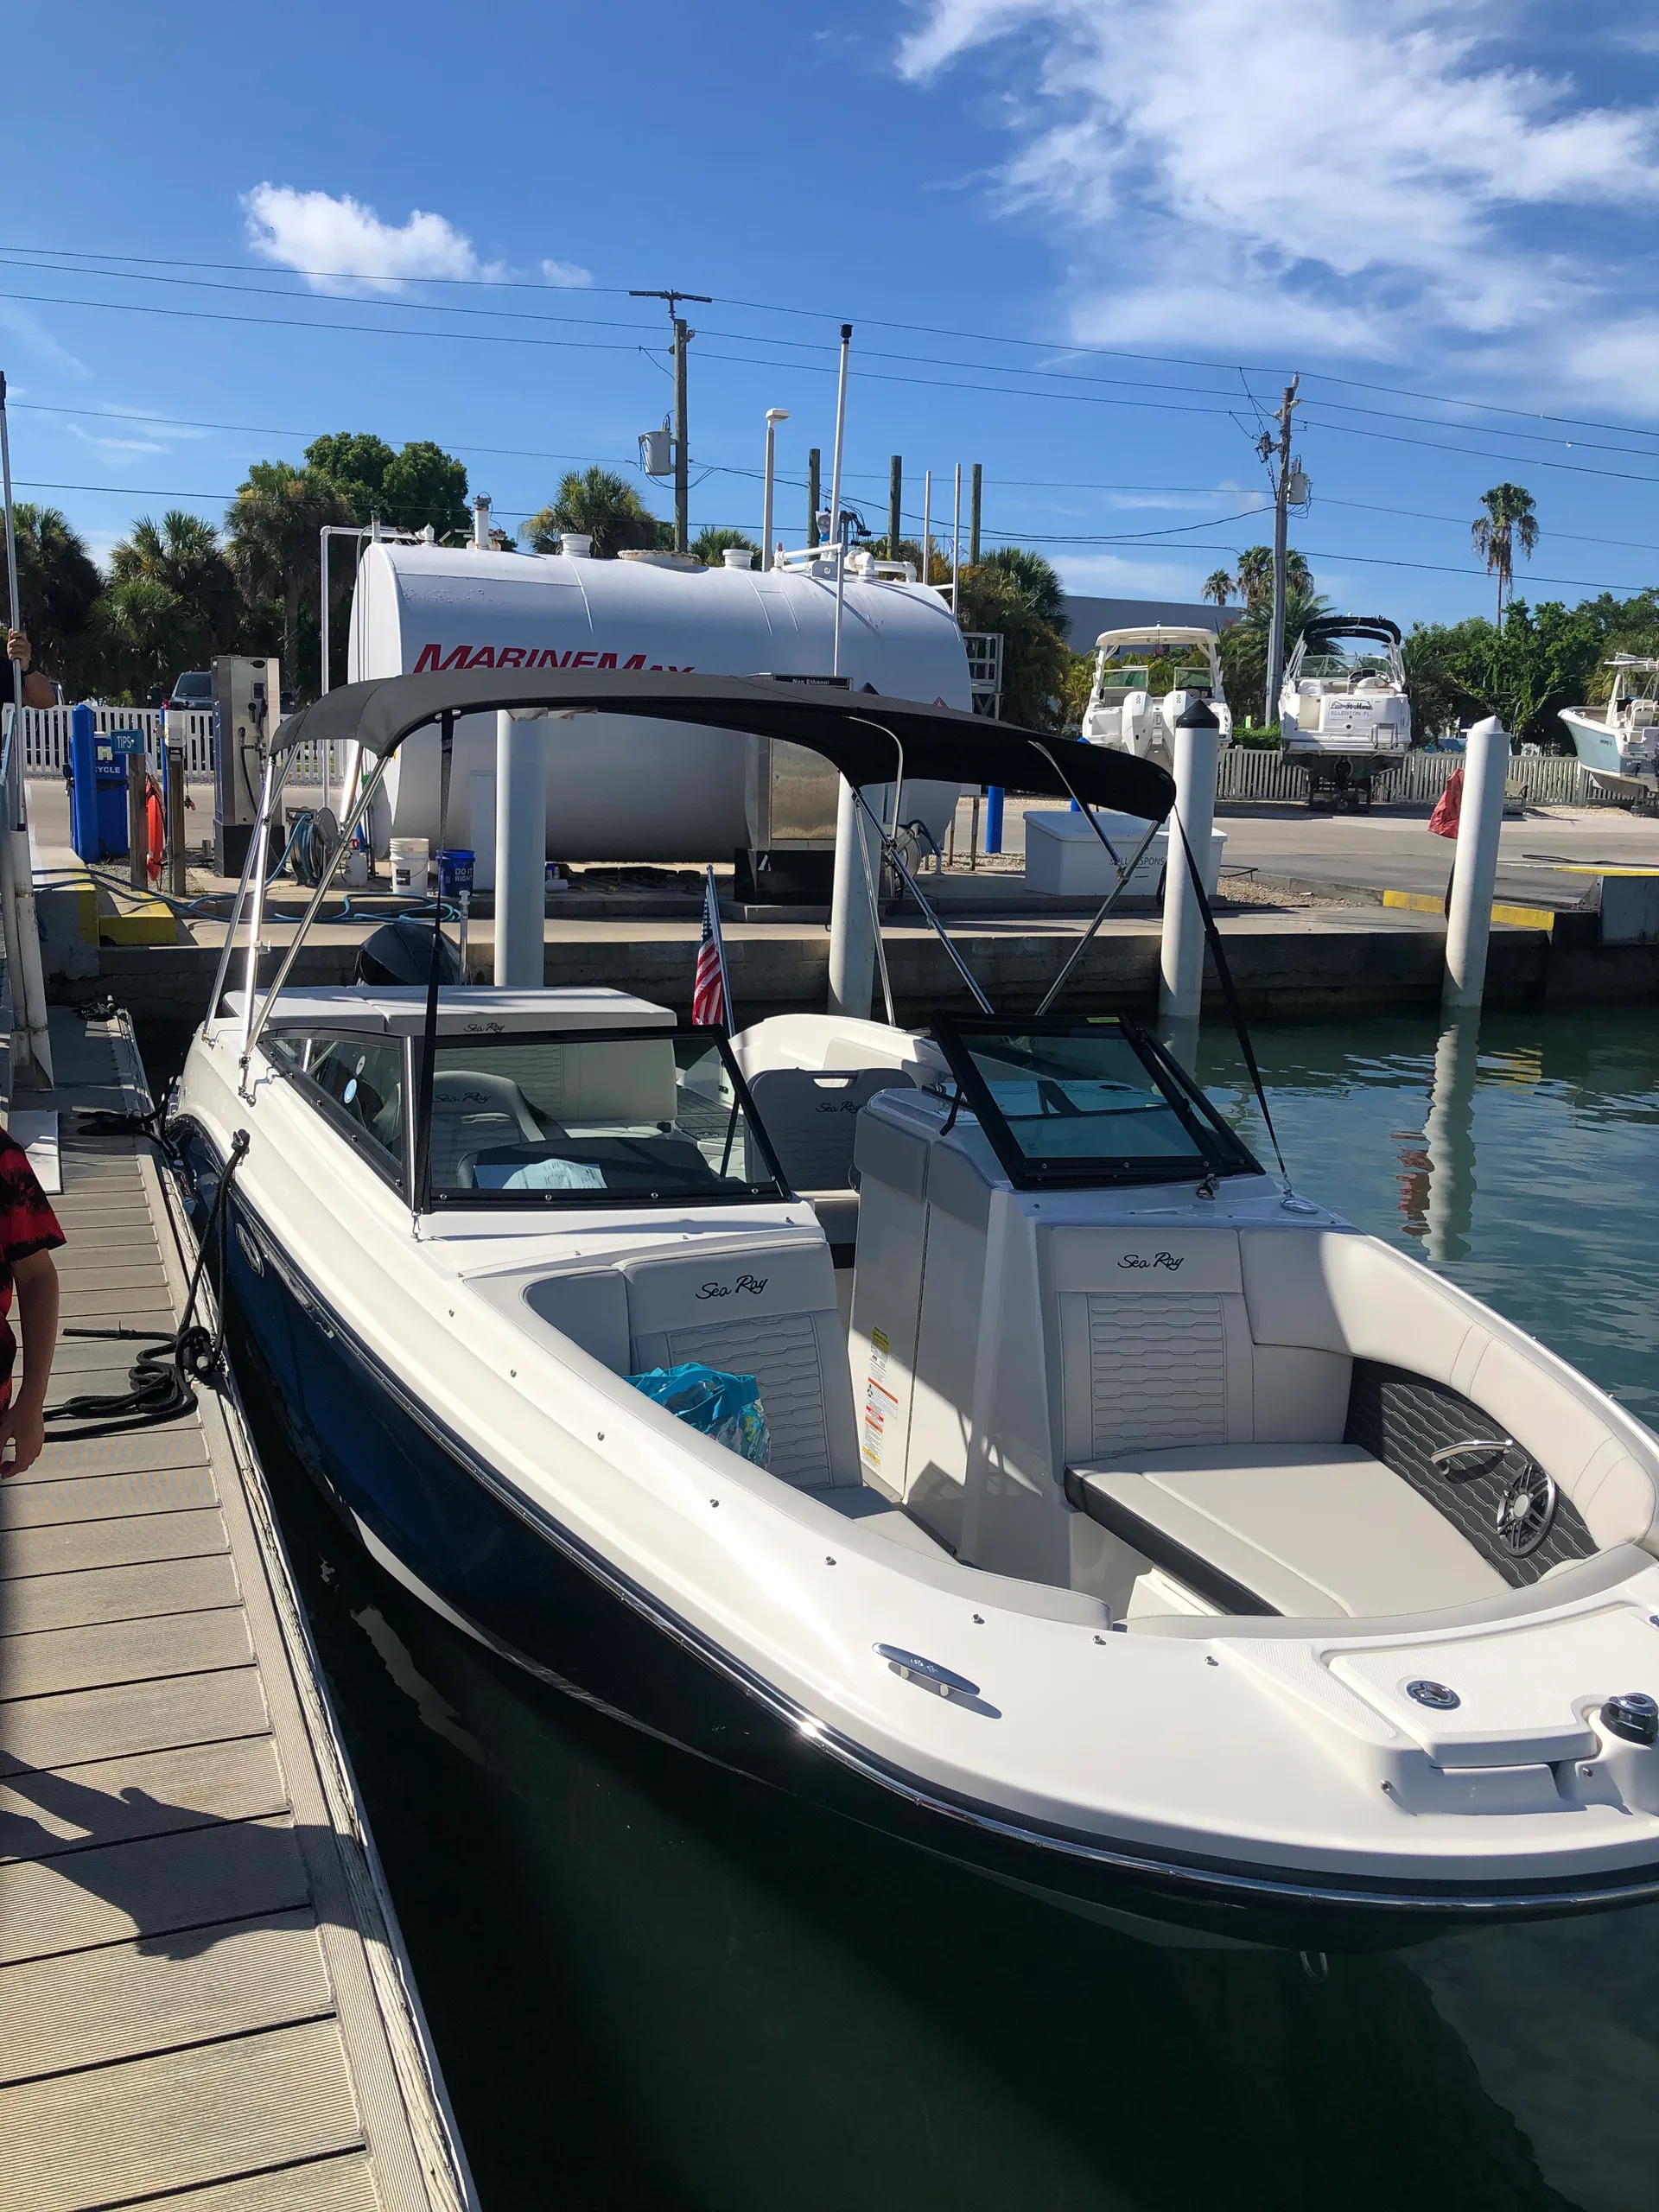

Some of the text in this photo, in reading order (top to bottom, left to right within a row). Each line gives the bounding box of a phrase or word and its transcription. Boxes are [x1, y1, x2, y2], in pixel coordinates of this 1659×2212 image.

[117, 735, 133, 749] TIPS
[463, 1022, 505, 1033] Sea Ray
[433, 1091, 491, 1103] Sea Ray
[815, 1101, 862, 1115] Sea Ray
[1117, 1251, 1185, 1271] Sea Ray
[695, 1274, 769, 1300] Sea Ray
